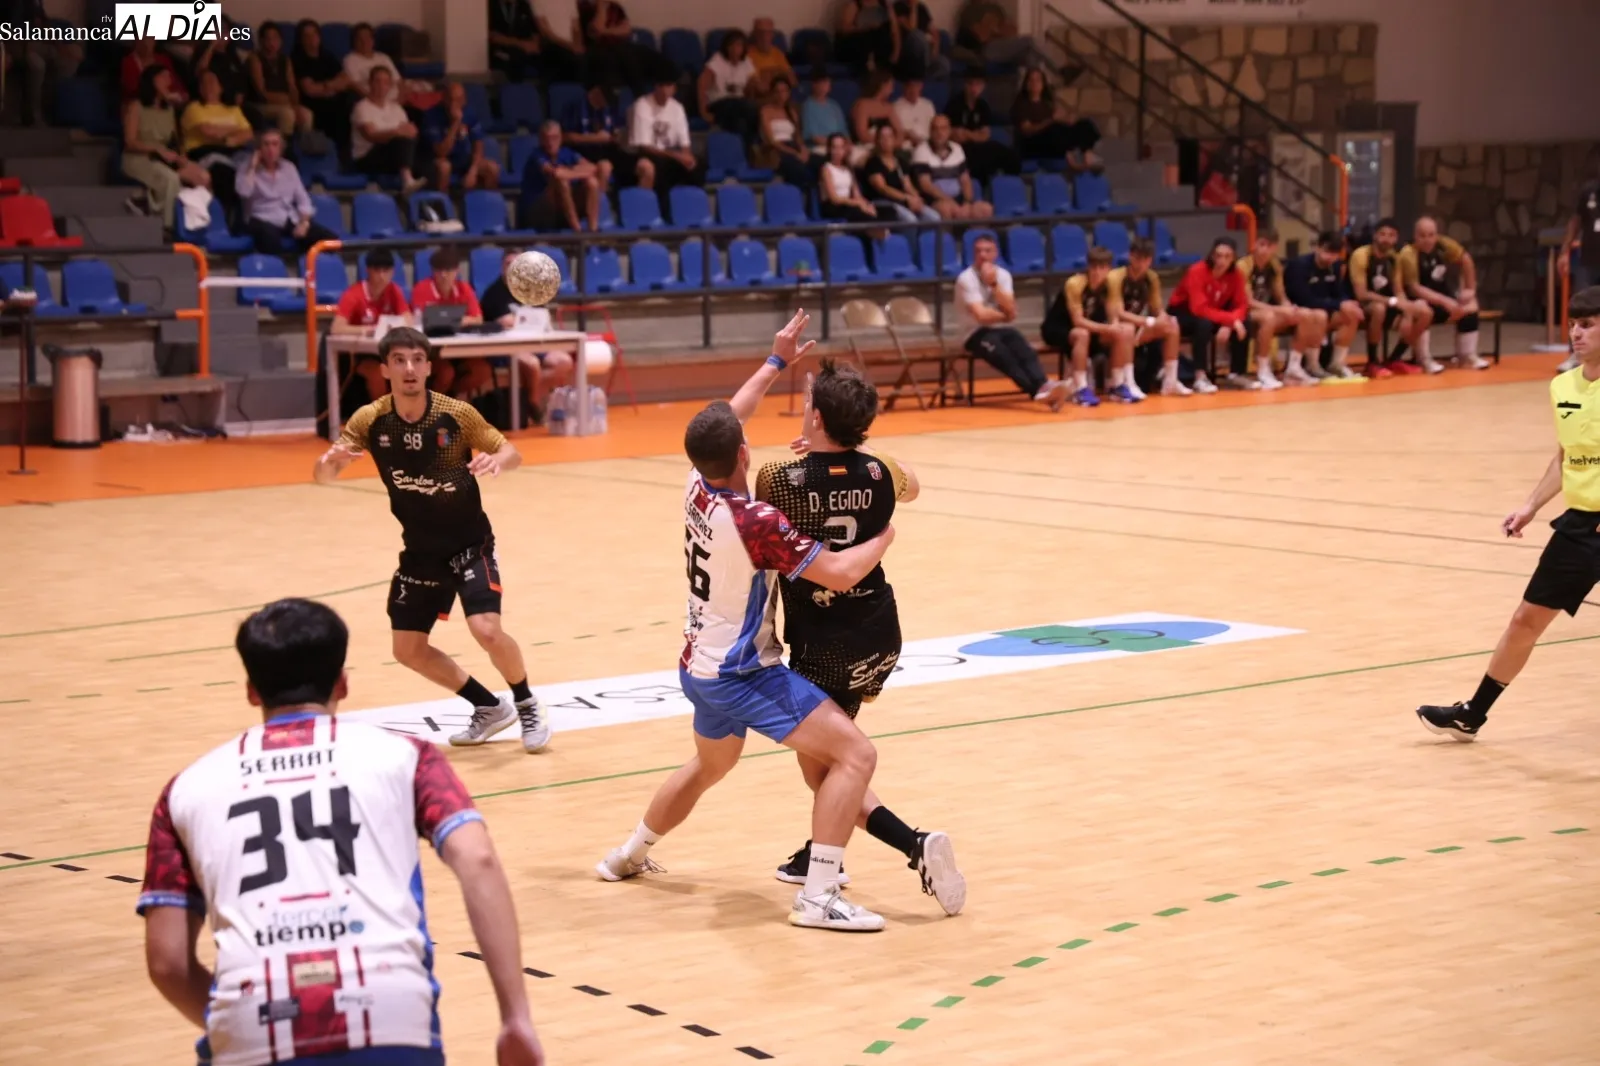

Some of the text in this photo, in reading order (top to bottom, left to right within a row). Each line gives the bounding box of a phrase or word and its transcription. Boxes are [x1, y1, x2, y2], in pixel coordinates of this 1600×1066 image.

[404, 433, 423, 451] 98
[829, 488, 873, 511] EGIDO
[227, 784, 361, 896] 34
